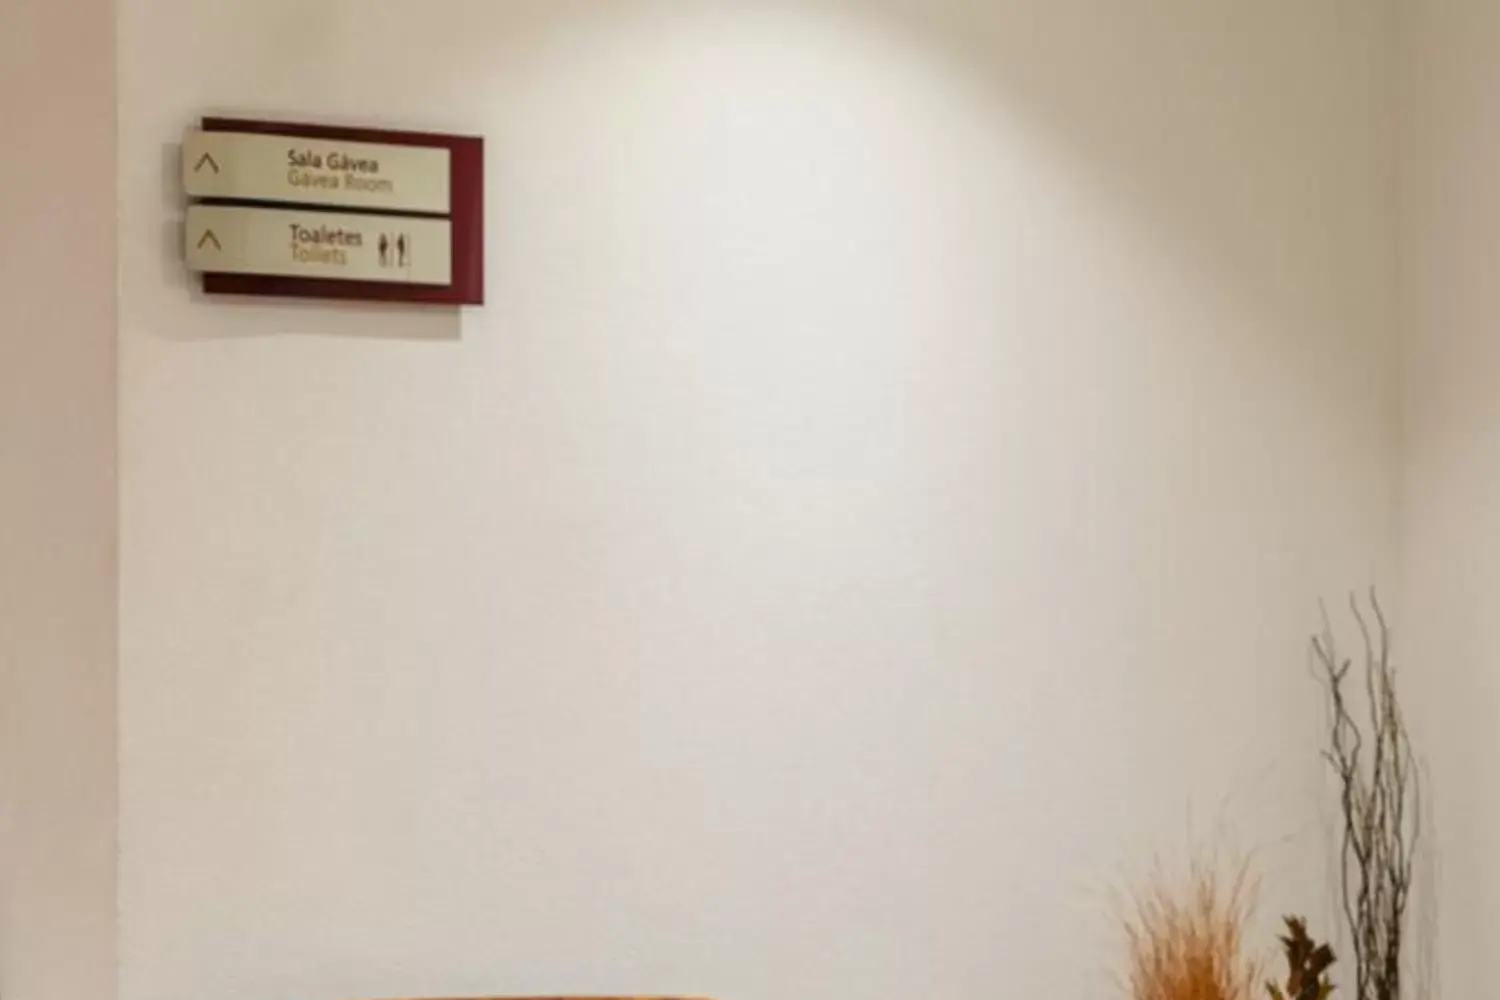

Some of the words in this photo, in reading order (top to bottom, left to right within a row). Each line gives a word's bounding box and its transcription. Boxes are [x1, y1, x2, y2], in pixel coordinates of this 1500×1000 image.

[287, 148, 322, 168] Sala
[326, 151, 379, 173] Gávea
[344, 173, 393, 193] Room
[288, 223, 362, 246] Toaletes
[289, 242, 347, 266] Toilets
